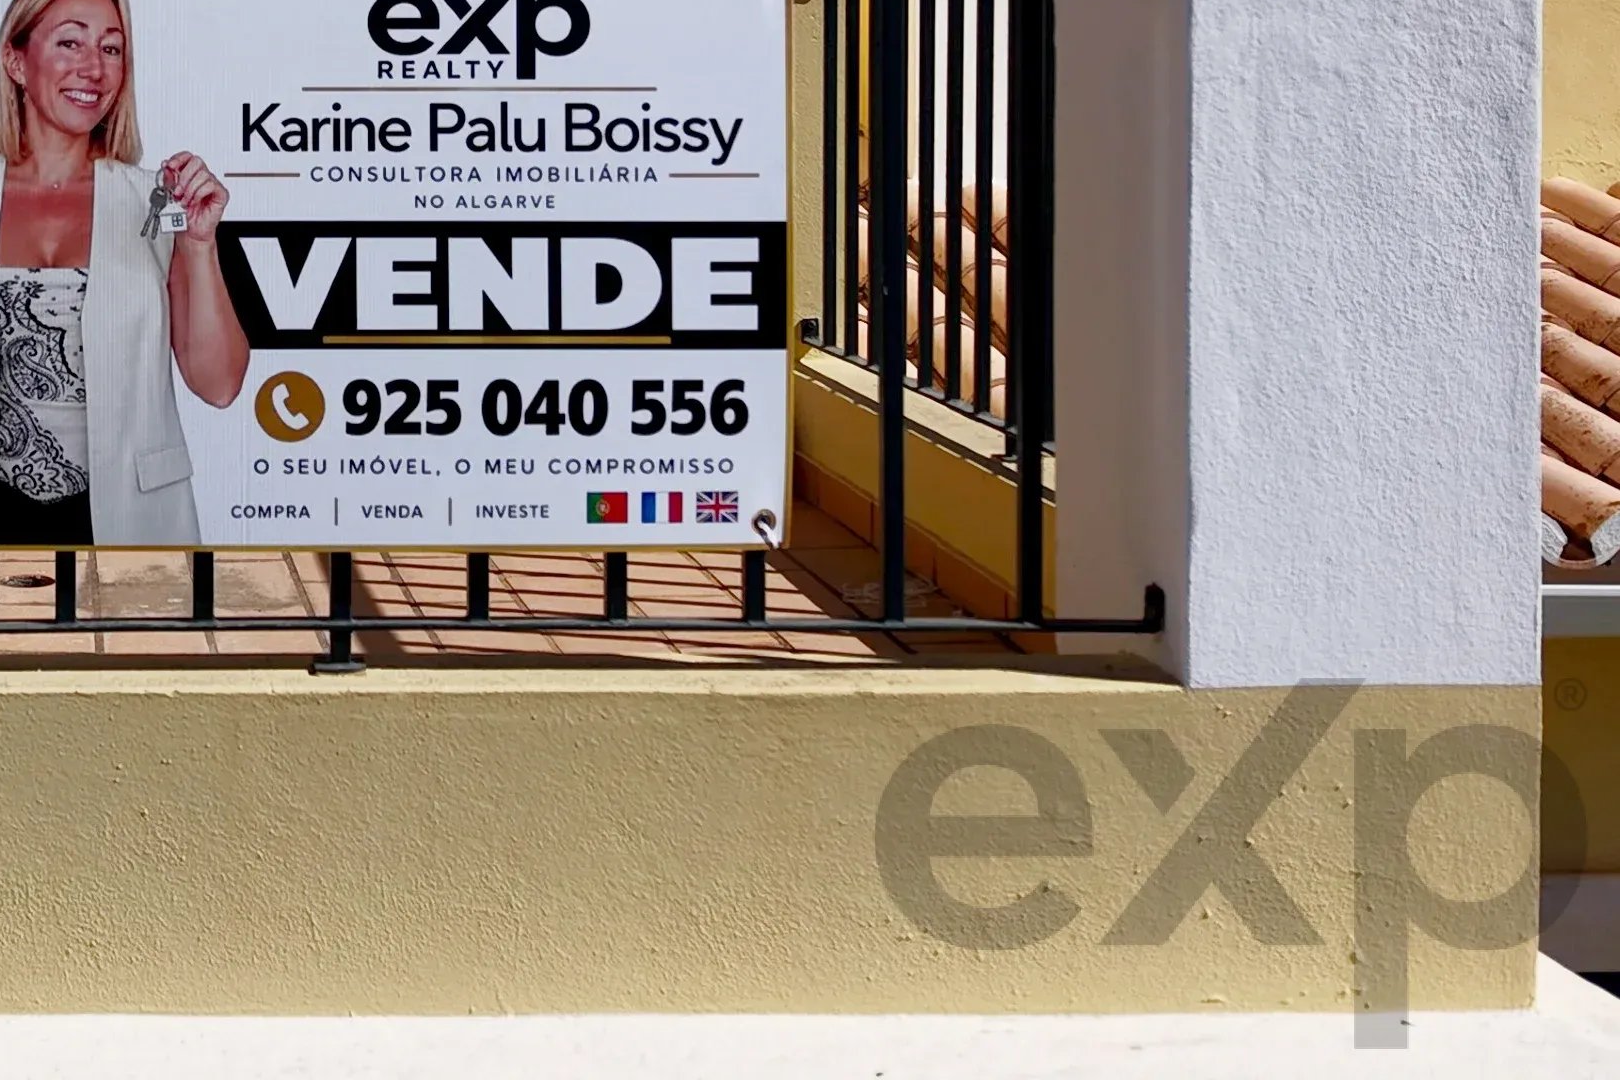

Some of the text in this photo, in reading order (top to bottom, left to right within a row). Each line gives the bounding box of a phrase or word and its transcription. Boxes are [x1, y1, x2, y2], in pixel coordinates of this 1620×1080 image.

[377, 60, 503, 79] REALTY
[242, 102, 743, 166] Karine Palu Boissy
[311, 163, 657, 182] CONSULTORA IMOBILIÁRIA
[414, 194, 555, 209] NO ALGARVE
[239, 237, 759, 331] VENDE
[342, 379, 748, 436] 925 040 556
[253, 455, 734, 476] O SEU IMÓVEL, O MEU COMPROMISSO
[230, 504, 549, 519] COMPRA VENDA INVESTE
